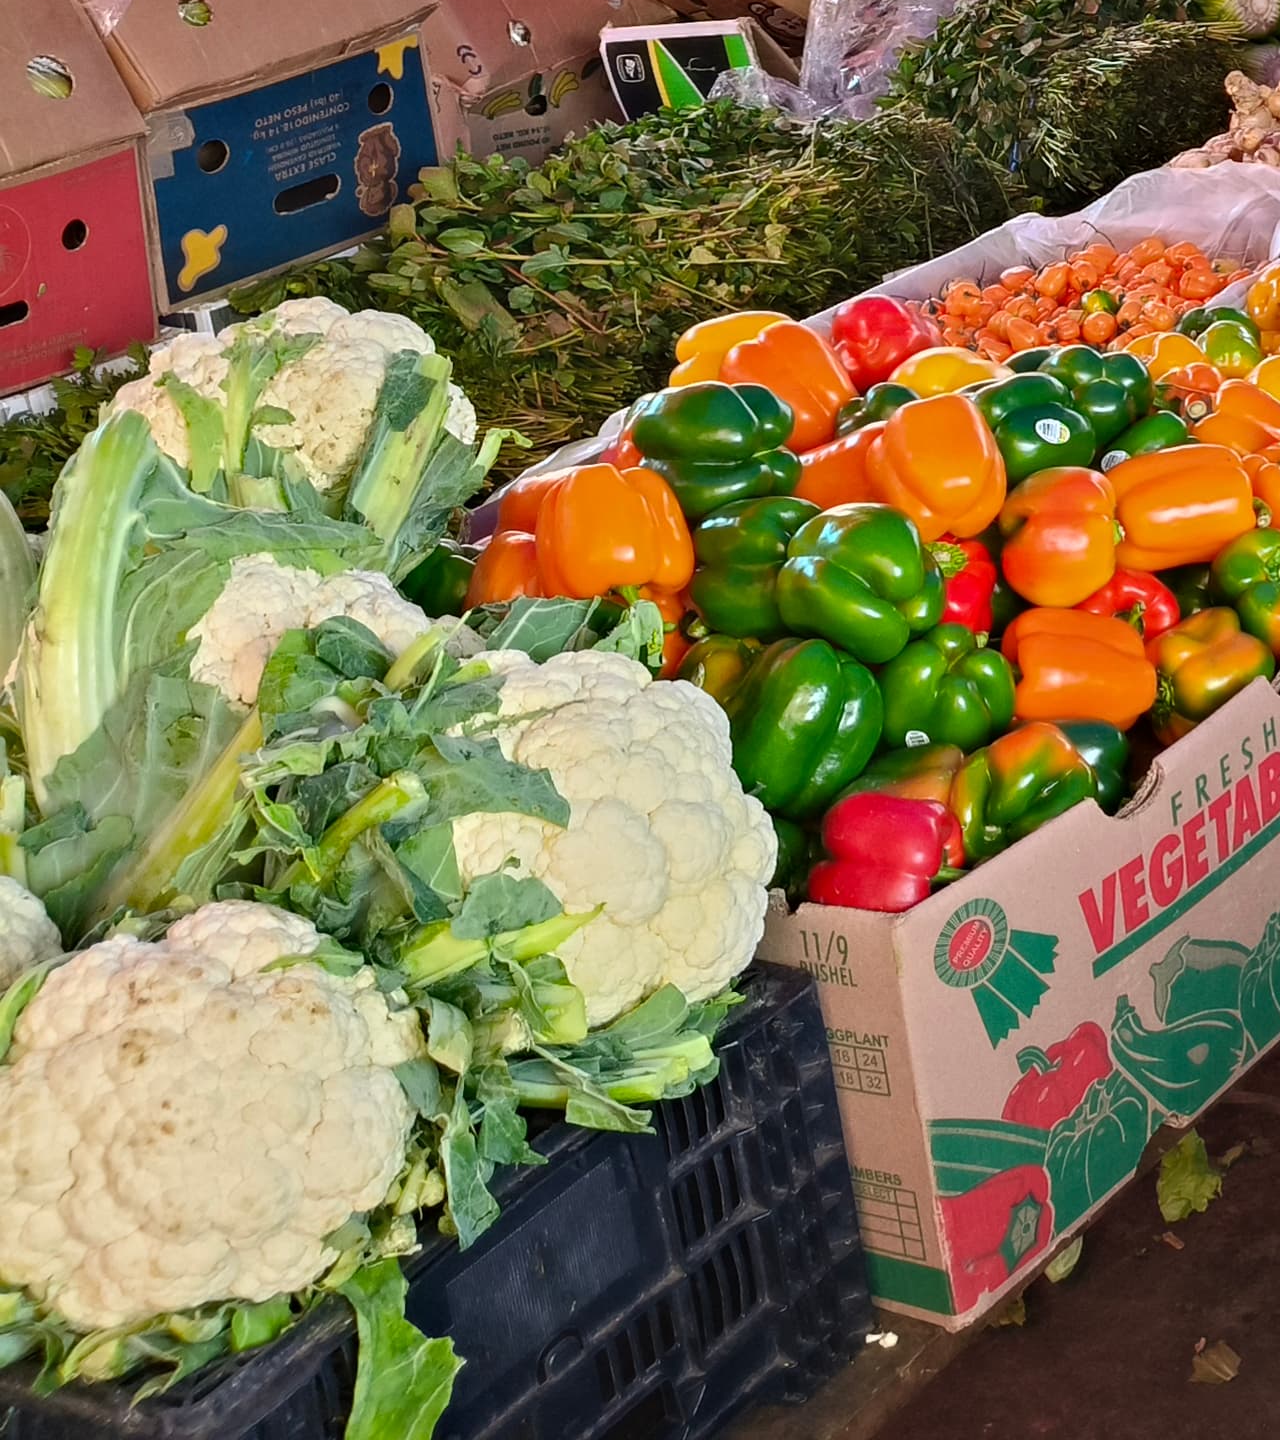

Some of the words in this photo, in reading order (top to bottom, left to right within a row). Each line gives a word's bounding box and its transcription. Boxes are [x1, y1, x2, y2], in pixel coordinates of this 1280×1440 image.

[283, 102, 309, 119] PESO
[296, 101, 350, 128] CONTENIDO
[254, 111, 282, 129] NETO
[492, 130, 514, 142] NETO
[495, 141, 512, 153] NET
[308, 151, 337, 168] CLASE
[274, 162, 307, 182] EXTRA
[1170, 715, 1278, 827] FRESH
[799, 929, 849, 966] 11/9
[951, 920, 981, 964] PREMIUM
[962, 927, 988, 968] QUALITY
[862, 1053, 880, 1068] 24
[865, 1075, 883, 1091] 32
